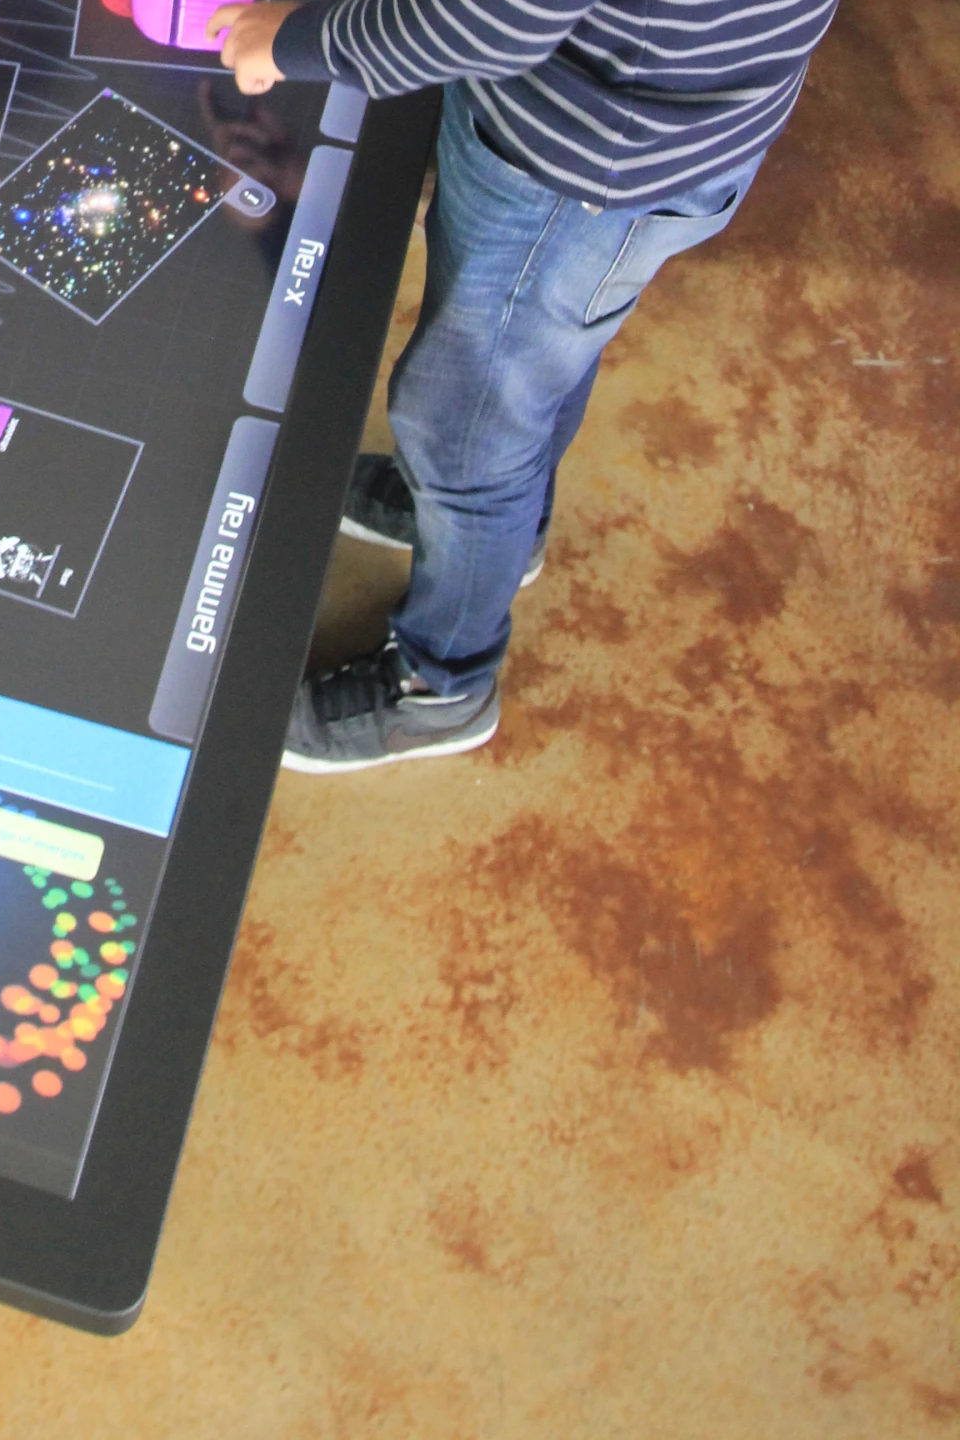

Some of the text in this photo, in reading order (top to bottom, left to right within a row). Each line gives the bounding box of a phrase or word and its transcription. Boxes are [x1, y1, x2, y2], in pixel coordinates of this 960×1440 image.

[284, 238, 325, 306] x-ray
[186, 492, 255, 654] gamma ray
